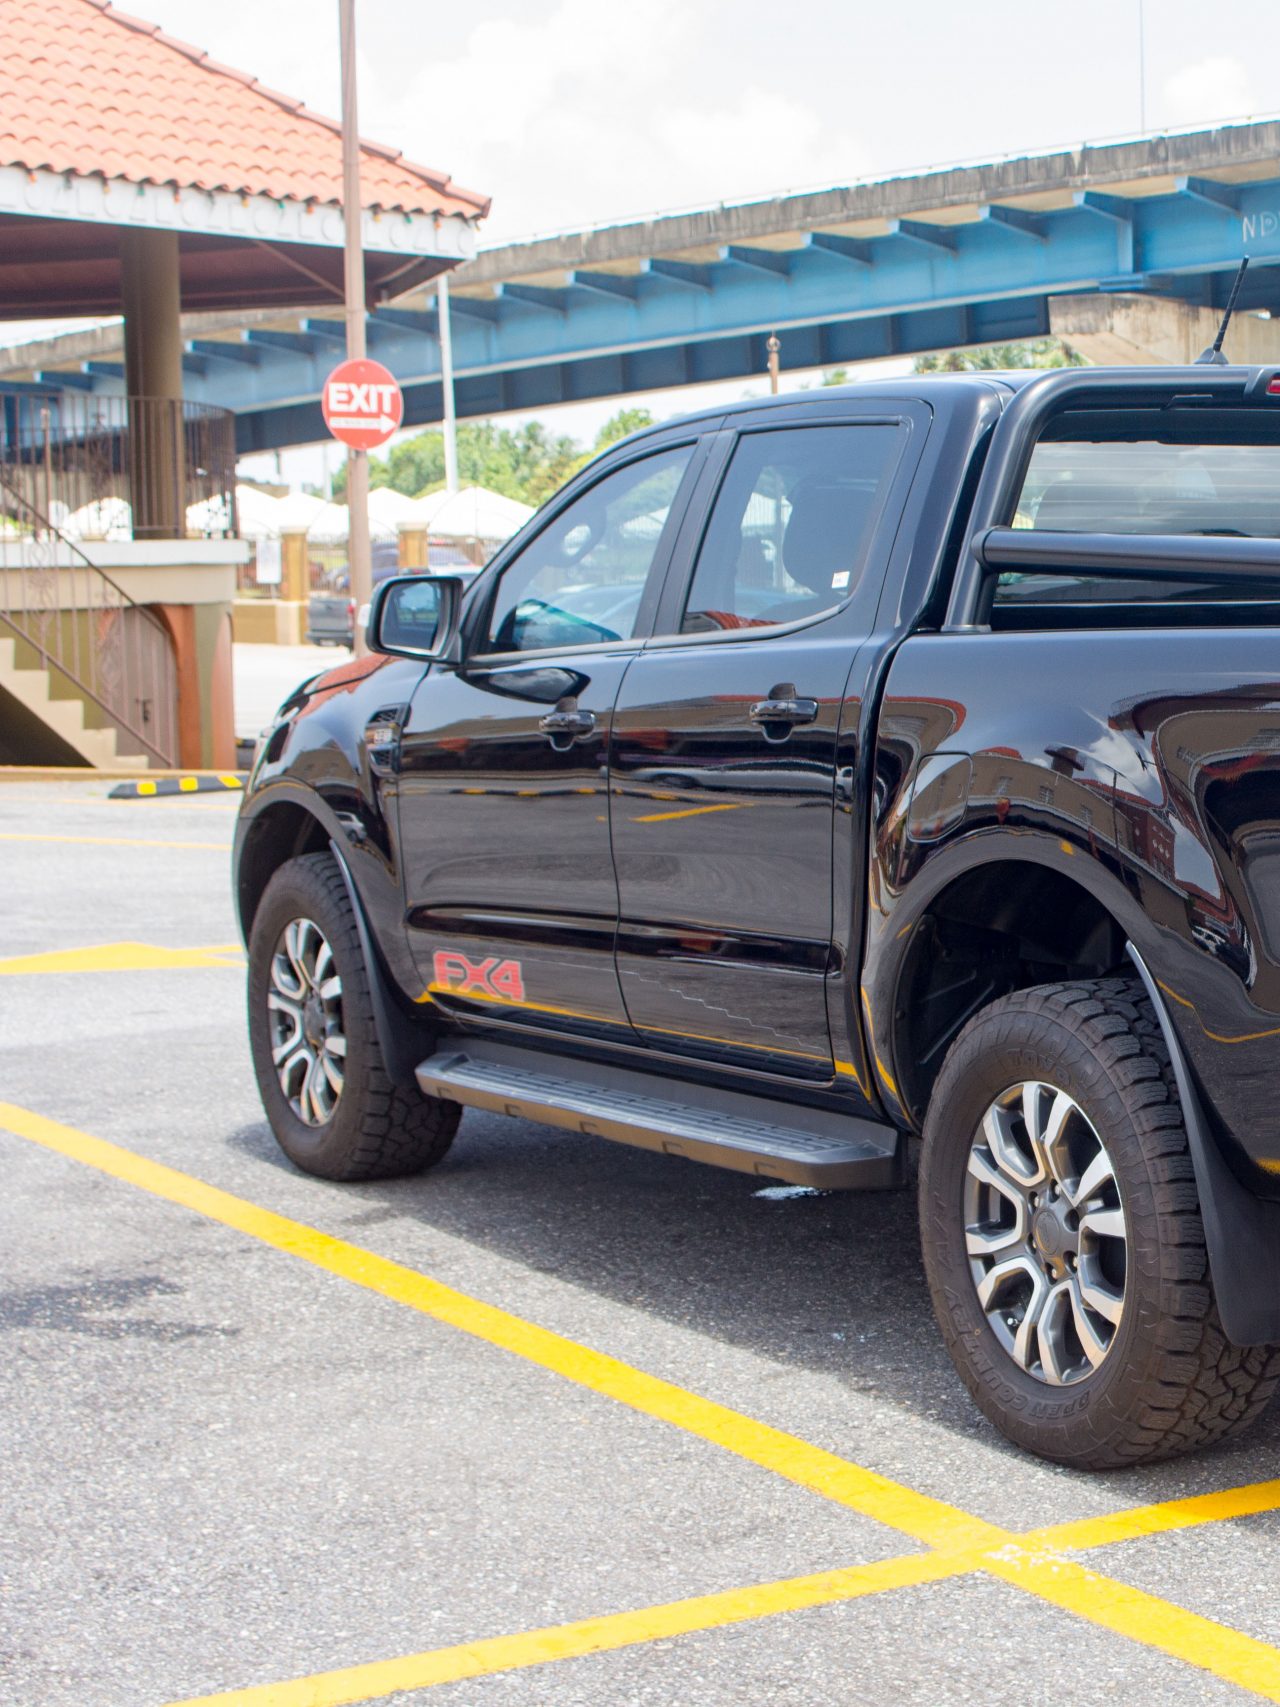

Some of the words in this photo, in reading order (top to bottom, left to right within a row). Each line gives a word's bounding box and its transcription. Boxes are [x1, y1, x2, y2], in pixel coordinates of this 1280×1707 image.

[328, 382, 397, 414] EXIT
[433, 950, 525, 1003] FX4
[943, 1284, 1029, 1412] COUNTRY
[1029, 1388, 1091, 1422] OPEN
